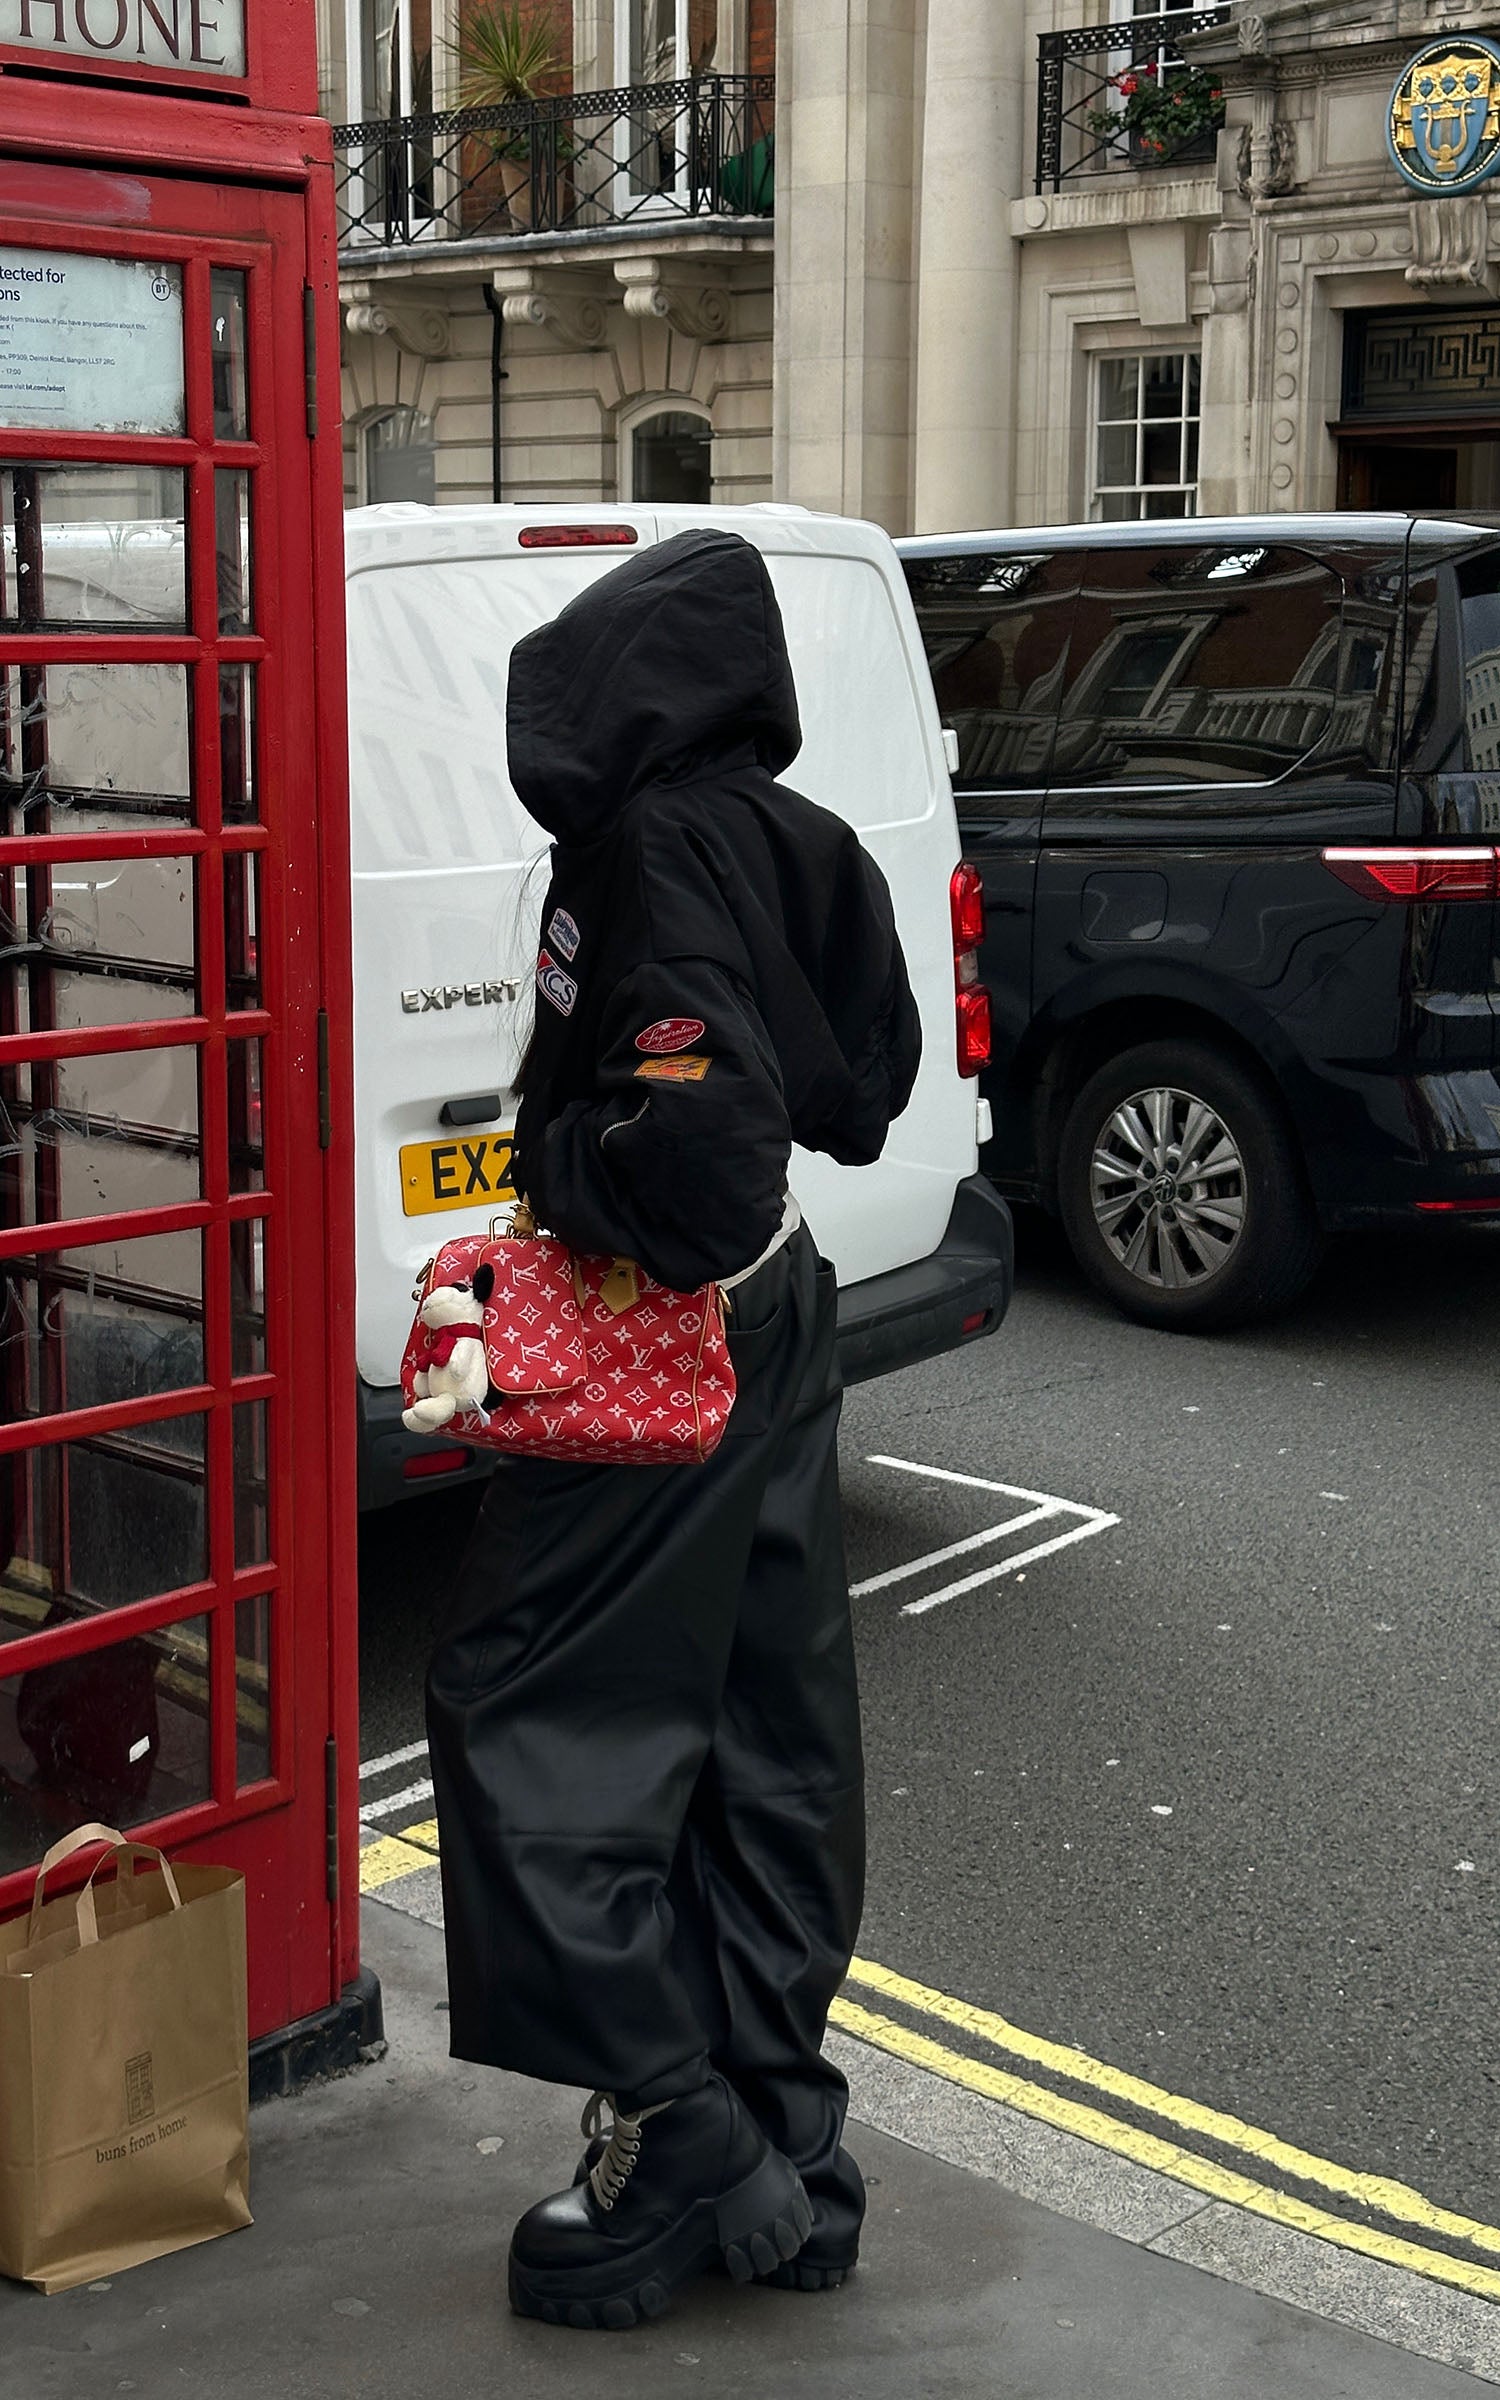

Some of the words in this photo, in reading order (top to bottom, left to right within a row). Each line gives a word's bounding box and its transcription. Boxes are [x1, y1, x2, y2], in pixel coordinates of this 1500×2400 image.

[46, 268, 66, 283] for
[155, 284, 167, 294] BT
[93, 321, 118, 329] questions
[26, 383, 66, 393] bt.com/adopt
[401, 978, 521, 1013] EXPERT
[95, 2145, 127, 2164] buns
[129, 2133, 157, 2155] from
[158, 2115, 188, 2140] home
